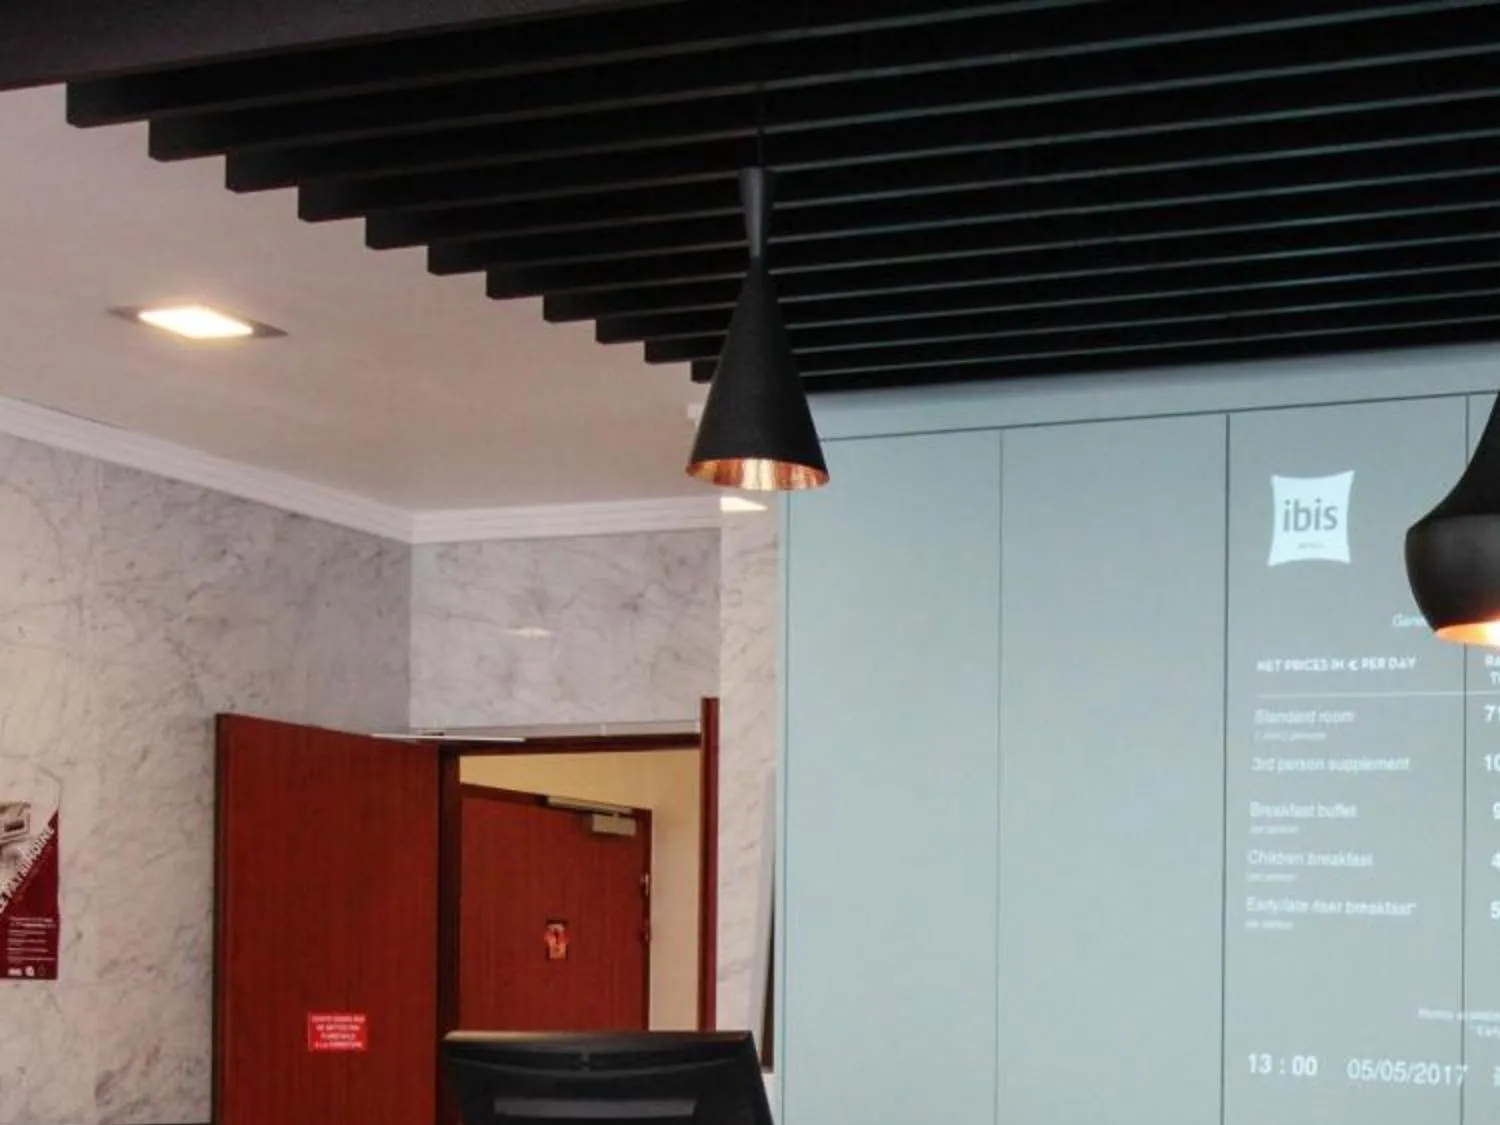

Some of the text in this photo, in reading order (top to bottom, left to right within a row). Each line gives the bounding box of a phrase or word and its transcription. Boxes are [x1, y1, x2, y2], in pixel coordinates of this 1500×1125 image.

[1282, 497, 1339, 532] ibis
[1361, 657, 1386, 671] PER
[1388, 655, 1418, 671] DAY
[1328, 757, 1410, 774] supplement
[1346, 1058, 1467, 1086] 05/05/2017
